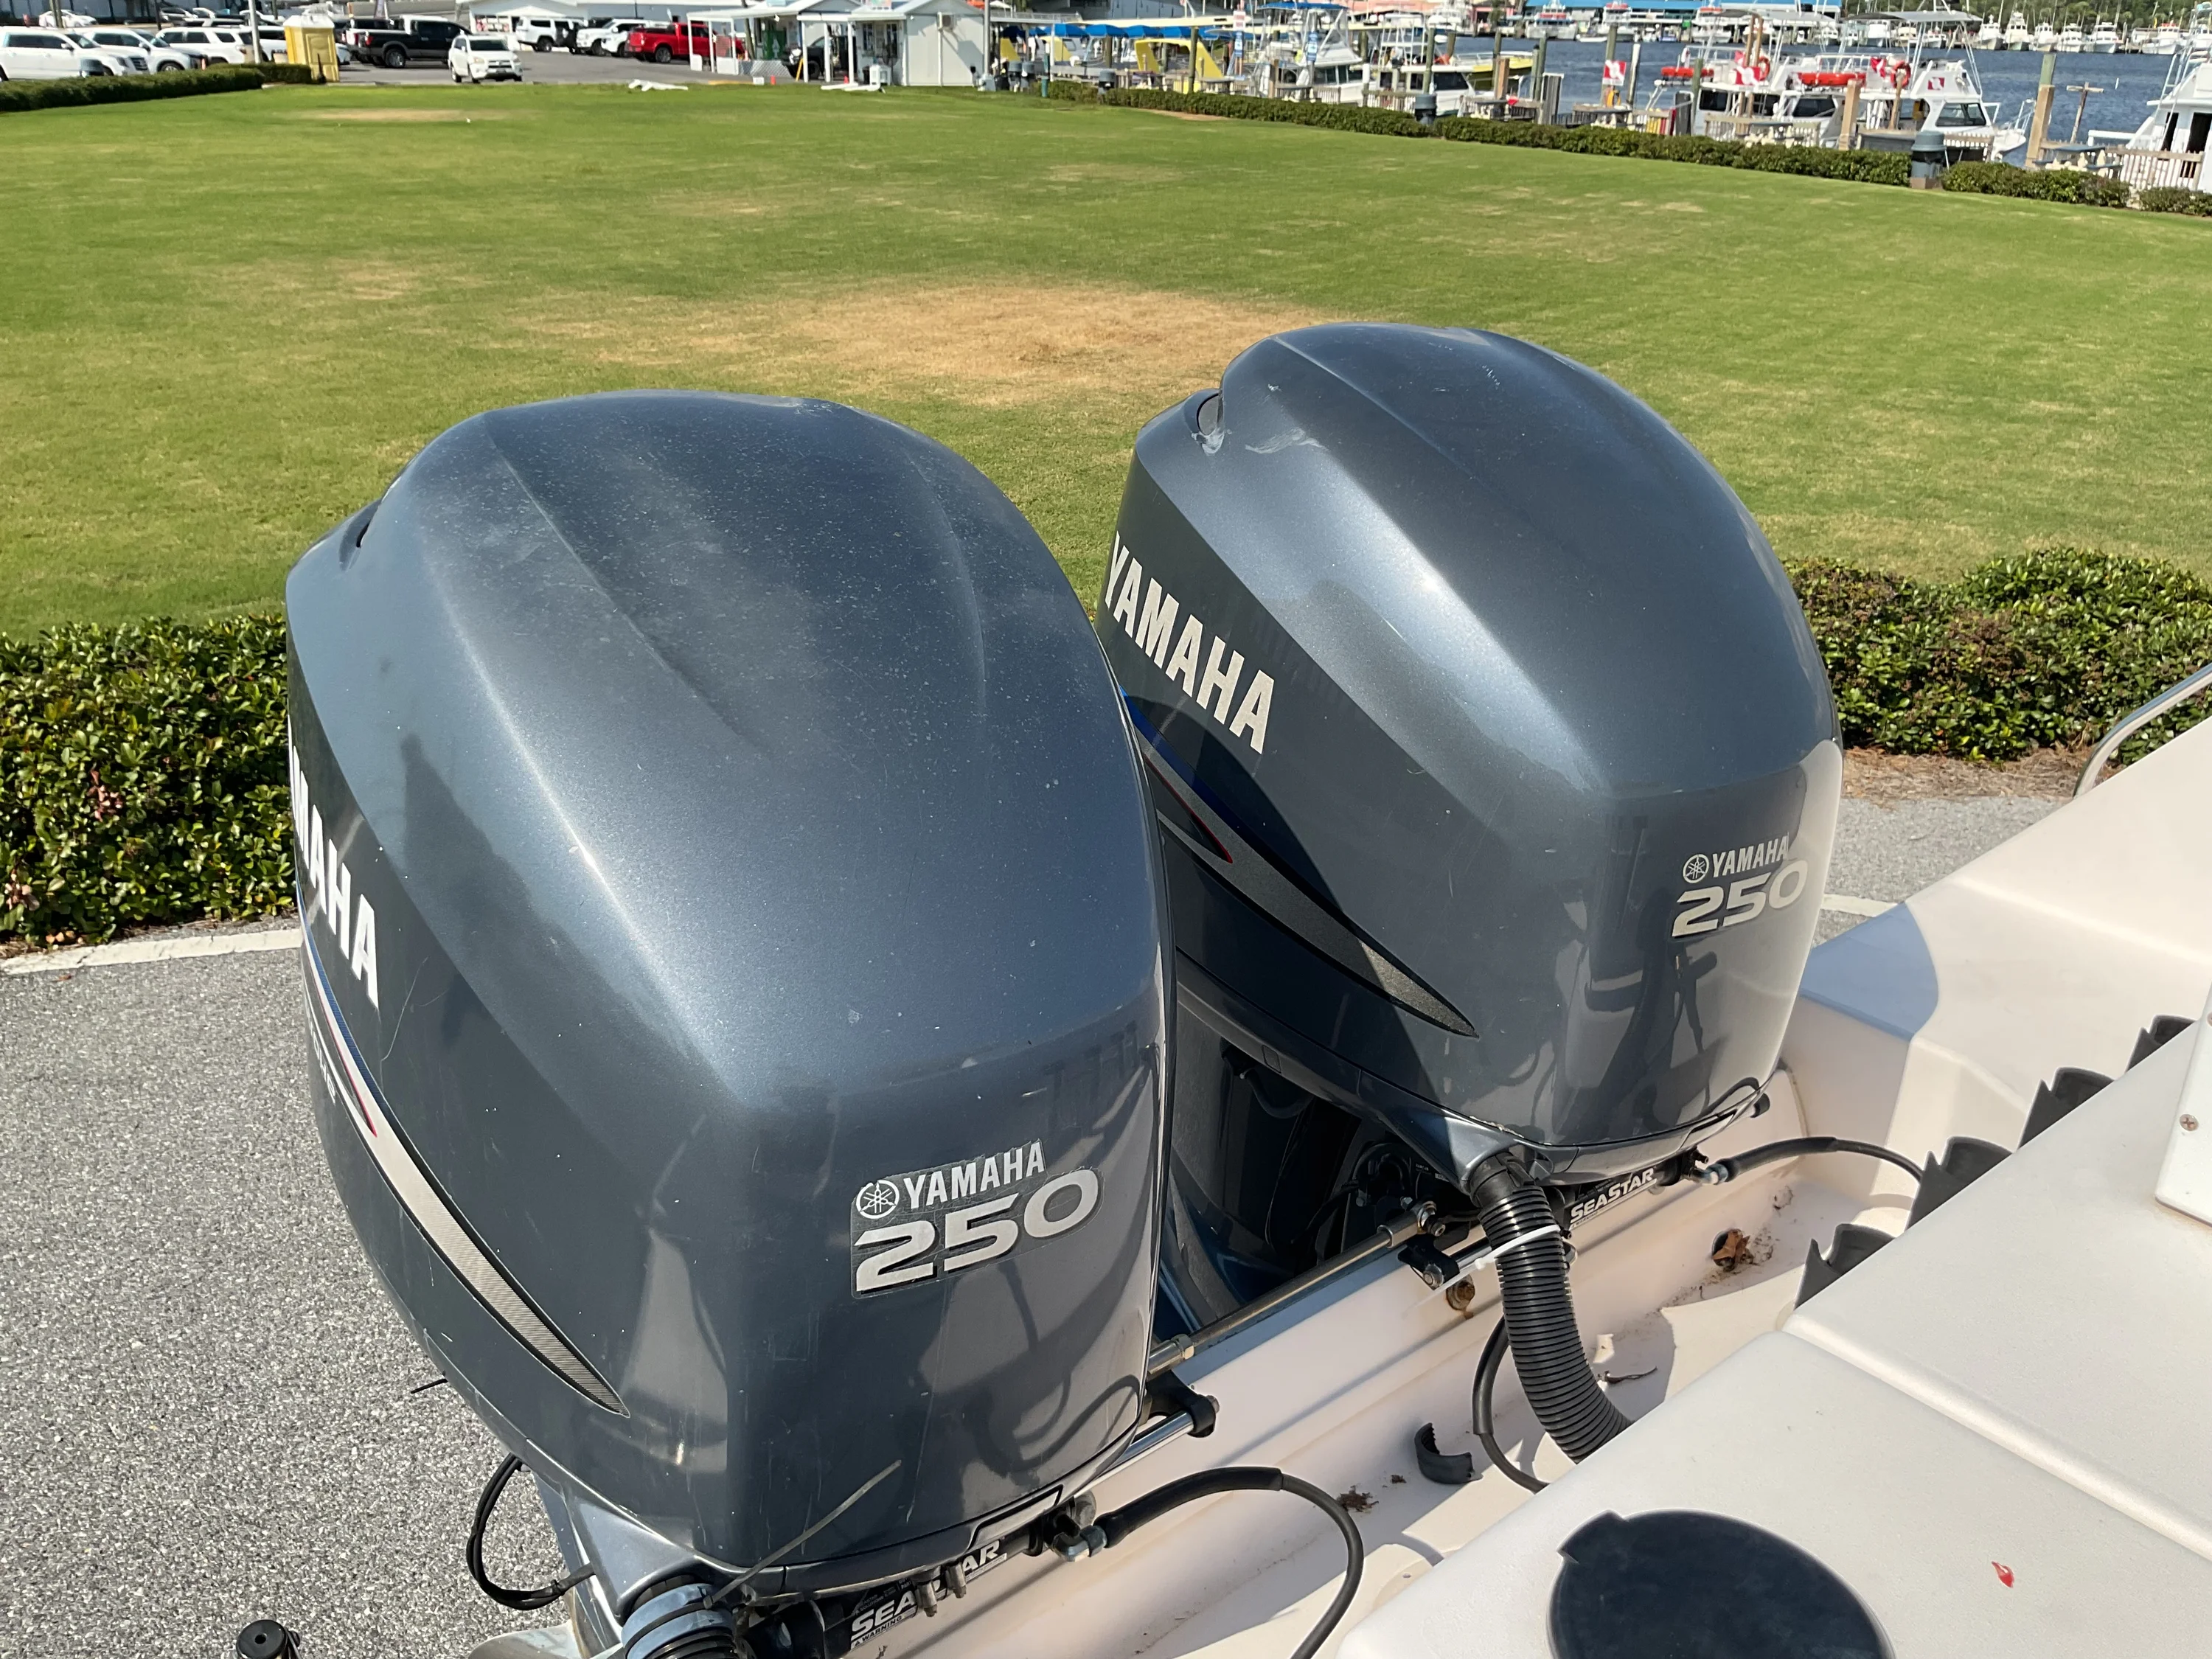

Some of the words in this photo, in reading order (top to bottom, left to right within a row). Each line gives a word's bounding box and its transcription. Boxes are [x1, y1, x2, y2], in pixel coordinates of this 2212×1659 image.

[1105, 530, 1275, 754] YAMAHA
[288, 714, 379, 1009] MAHA
[1672, 860, 1808, 937] 250
[1712, 835, 1789, 877] YAMAHA
[903, 1141, 1045, 1209] YAMAHA
[854, 1169, 1099, 1292] 250
[850, 1539, 1001, 1641] SEAAR
[861, 1615, 902, 1646] WARNING
